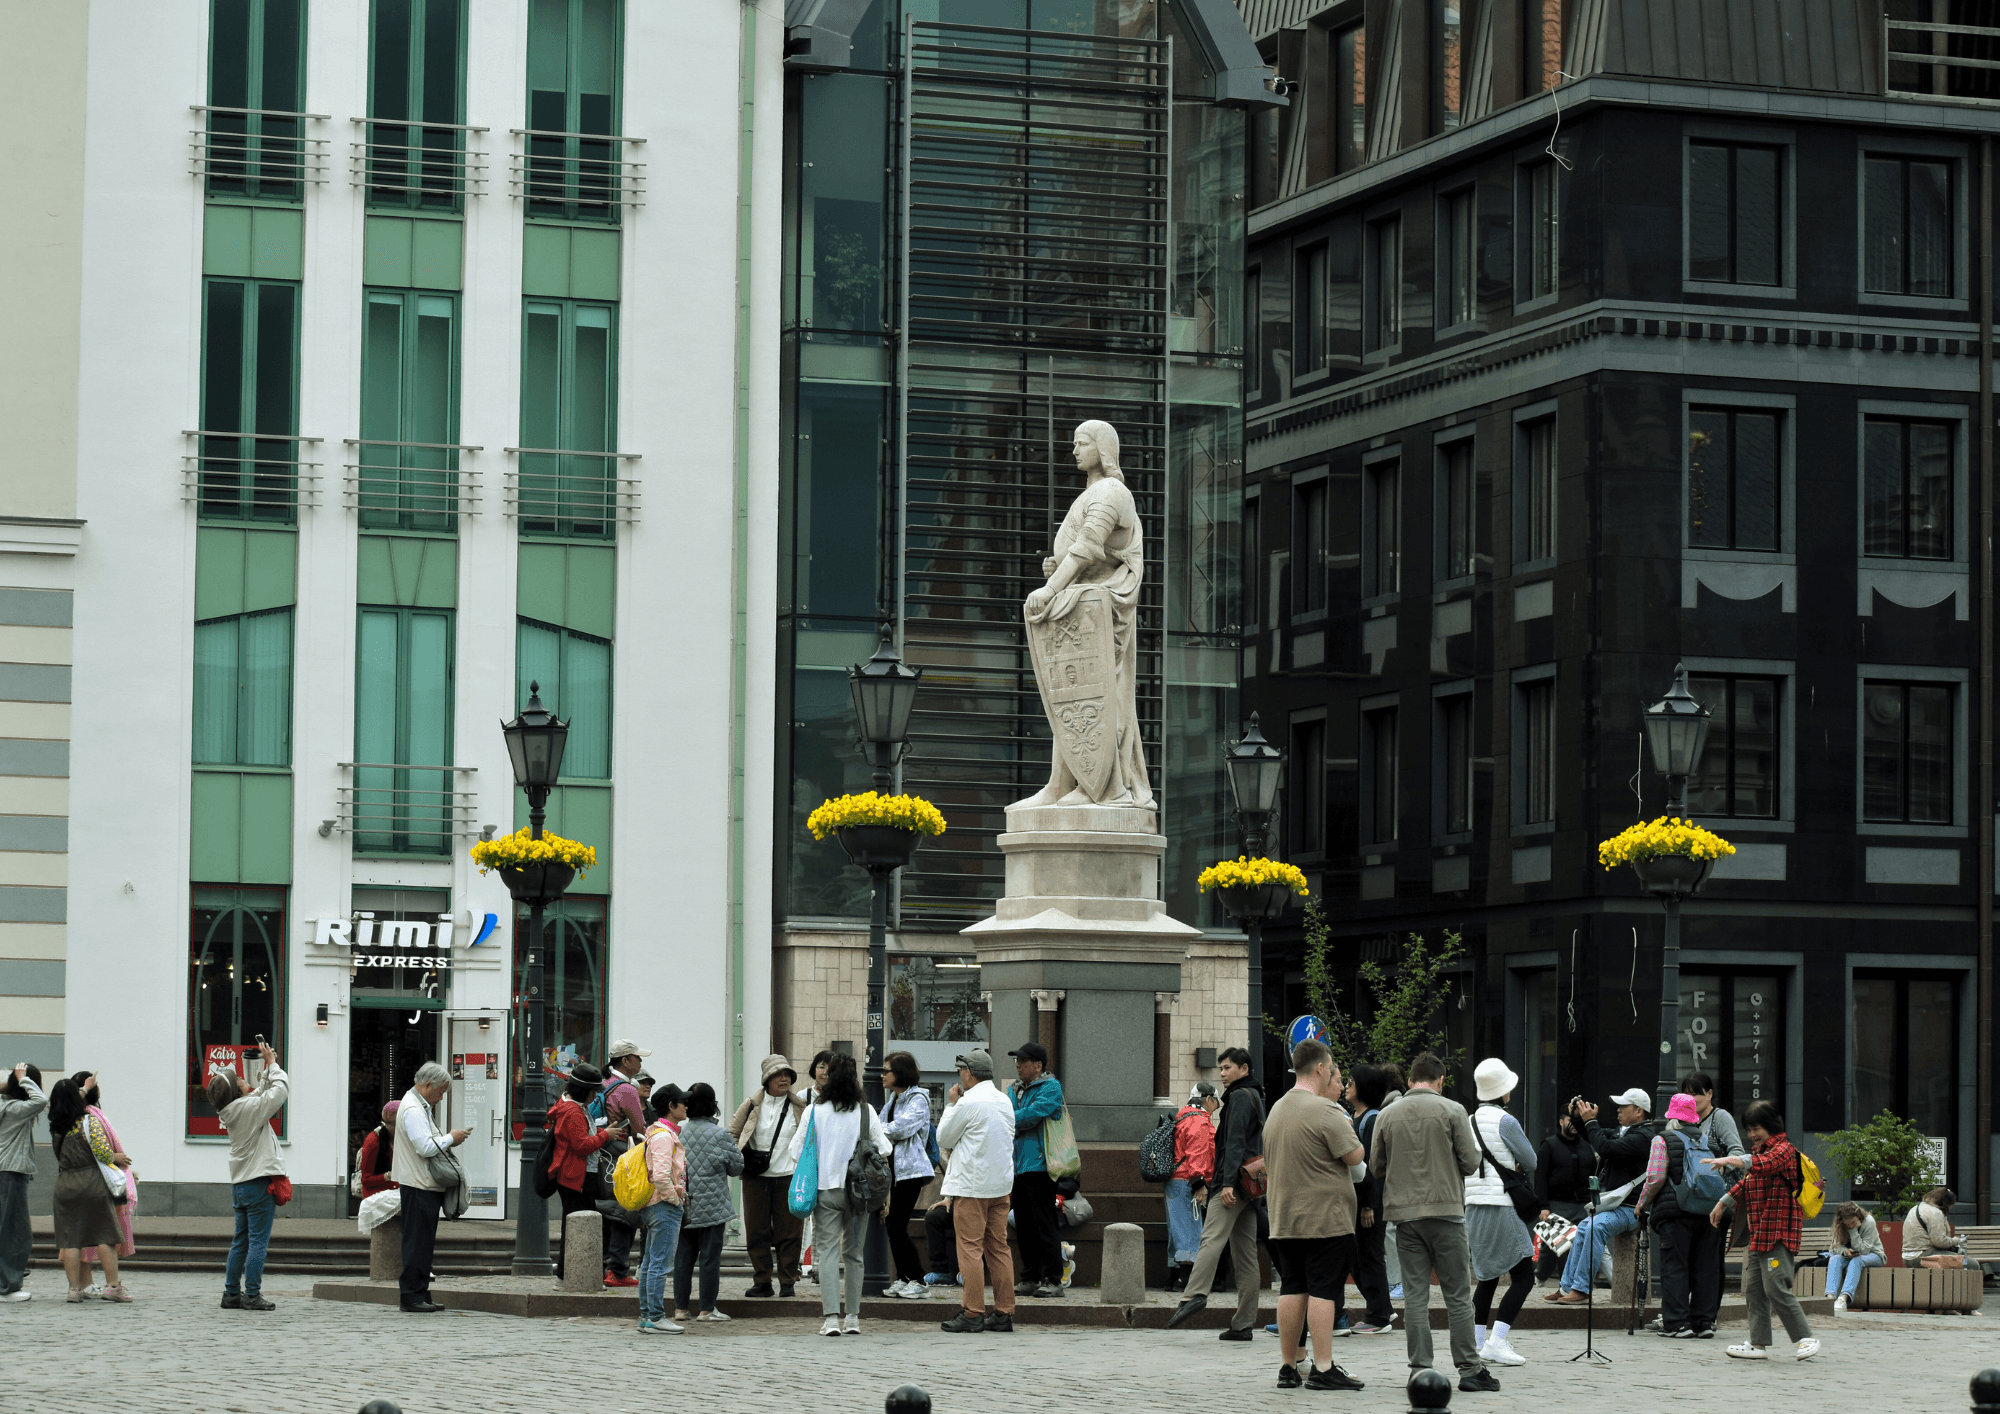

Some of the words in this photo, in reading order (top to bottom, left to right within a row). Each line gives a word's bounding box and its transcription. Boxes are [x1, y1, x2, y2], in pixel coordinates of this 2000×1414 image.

[314, 911, 454, 948] Rimi
[353, 955, 448, 968] EXPRESS
[1691, 991, 1708, 1060] FOR
